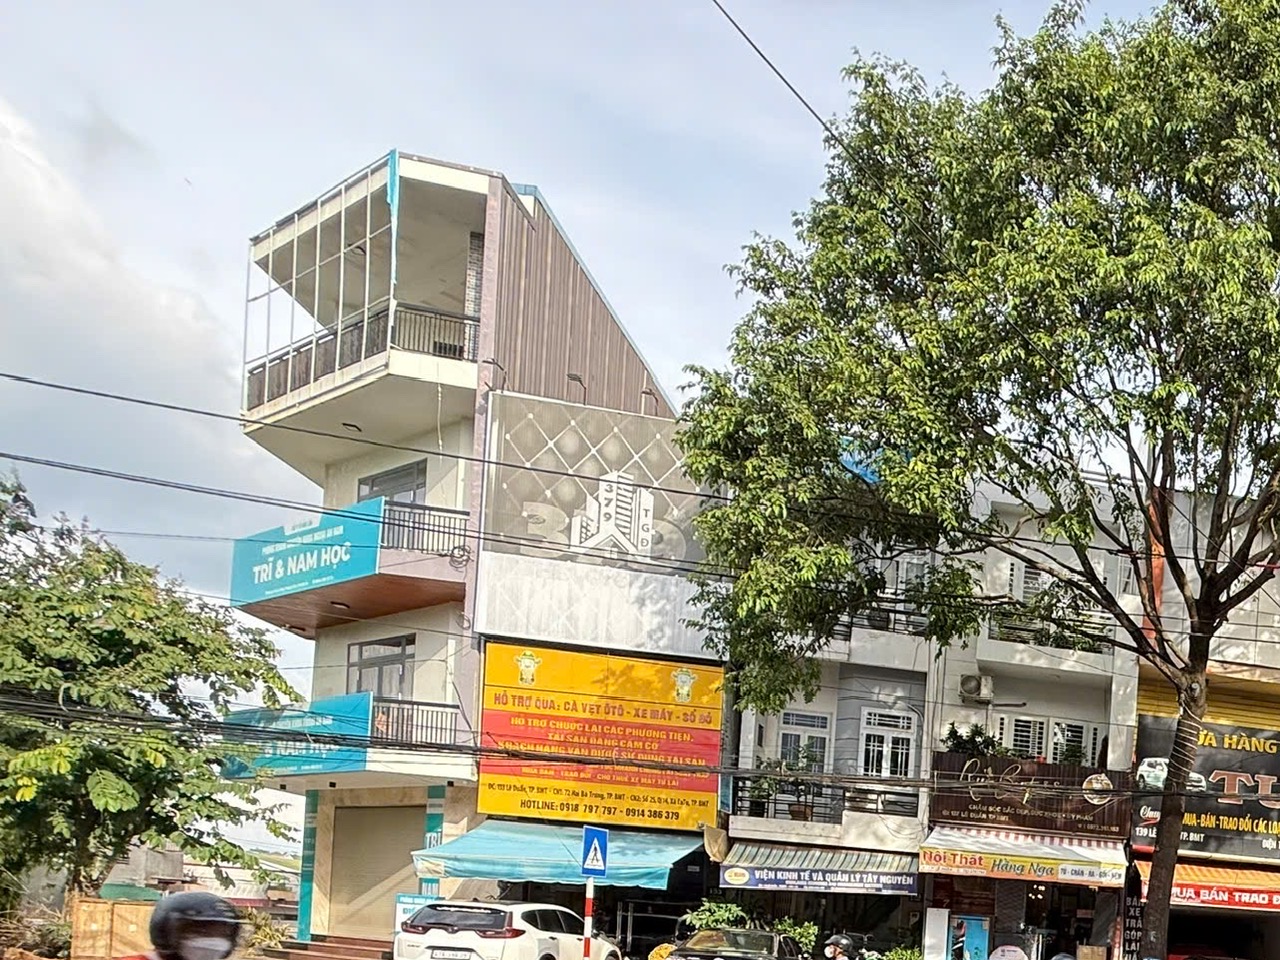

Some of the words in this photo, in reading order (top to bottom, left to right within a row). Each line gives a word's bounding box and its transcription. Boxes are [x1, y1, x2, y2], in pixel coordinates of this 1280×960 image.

[252, 557, 274, 584] TRĨ
[275, 560, 284, 580] &
[287, 551, 317, 576] NAM
[320, 541, 352, 570] HỌC
[511, 694, 532, 710] TRỢ
[564, 700, 578, 712] CÀ
[581, 702, 602, 716] VẸT
[633, 708, 648, 719] XE
[650, 708, 673, 721] MÁY
[1224, 731, 1278, 754] HÀNG
[520, 799, 558, 811] HOTLINE:
[560, 802, 580, 812] 0918
[584, 804, 599, 814] 797
[602, 806, 618, 815] 797
[626, 808, 645, 818] 0914
[664, 810, 680, 820] 379
[1135, 826, 1148, 836] 139
[1148, 826, 1158, 838] LÊ
[1239, 813, 1252, 832] ĐỔI
[1253, 817, 1267, 834] CÁC
[754, 868, 775, 881] VIỆN
[776, 870, 798, 880] KINH
[800, 870, 811, 881] TẾ
[812, 871, 824, 881] VÀ
[825, 872, 848, 883] QUẢN
[850, 872, 861, 882] LÝ
[862, 873, 878, 884] TÂY
[880, 874, 914, 885] NGUYÊN
[1028, 862, 1054, 877] Nga
[1200, 887, 1228, 902] BÁN
[1233, 891, 1269, 904] TRAO
[1128, 908, 1141, 917] XE
